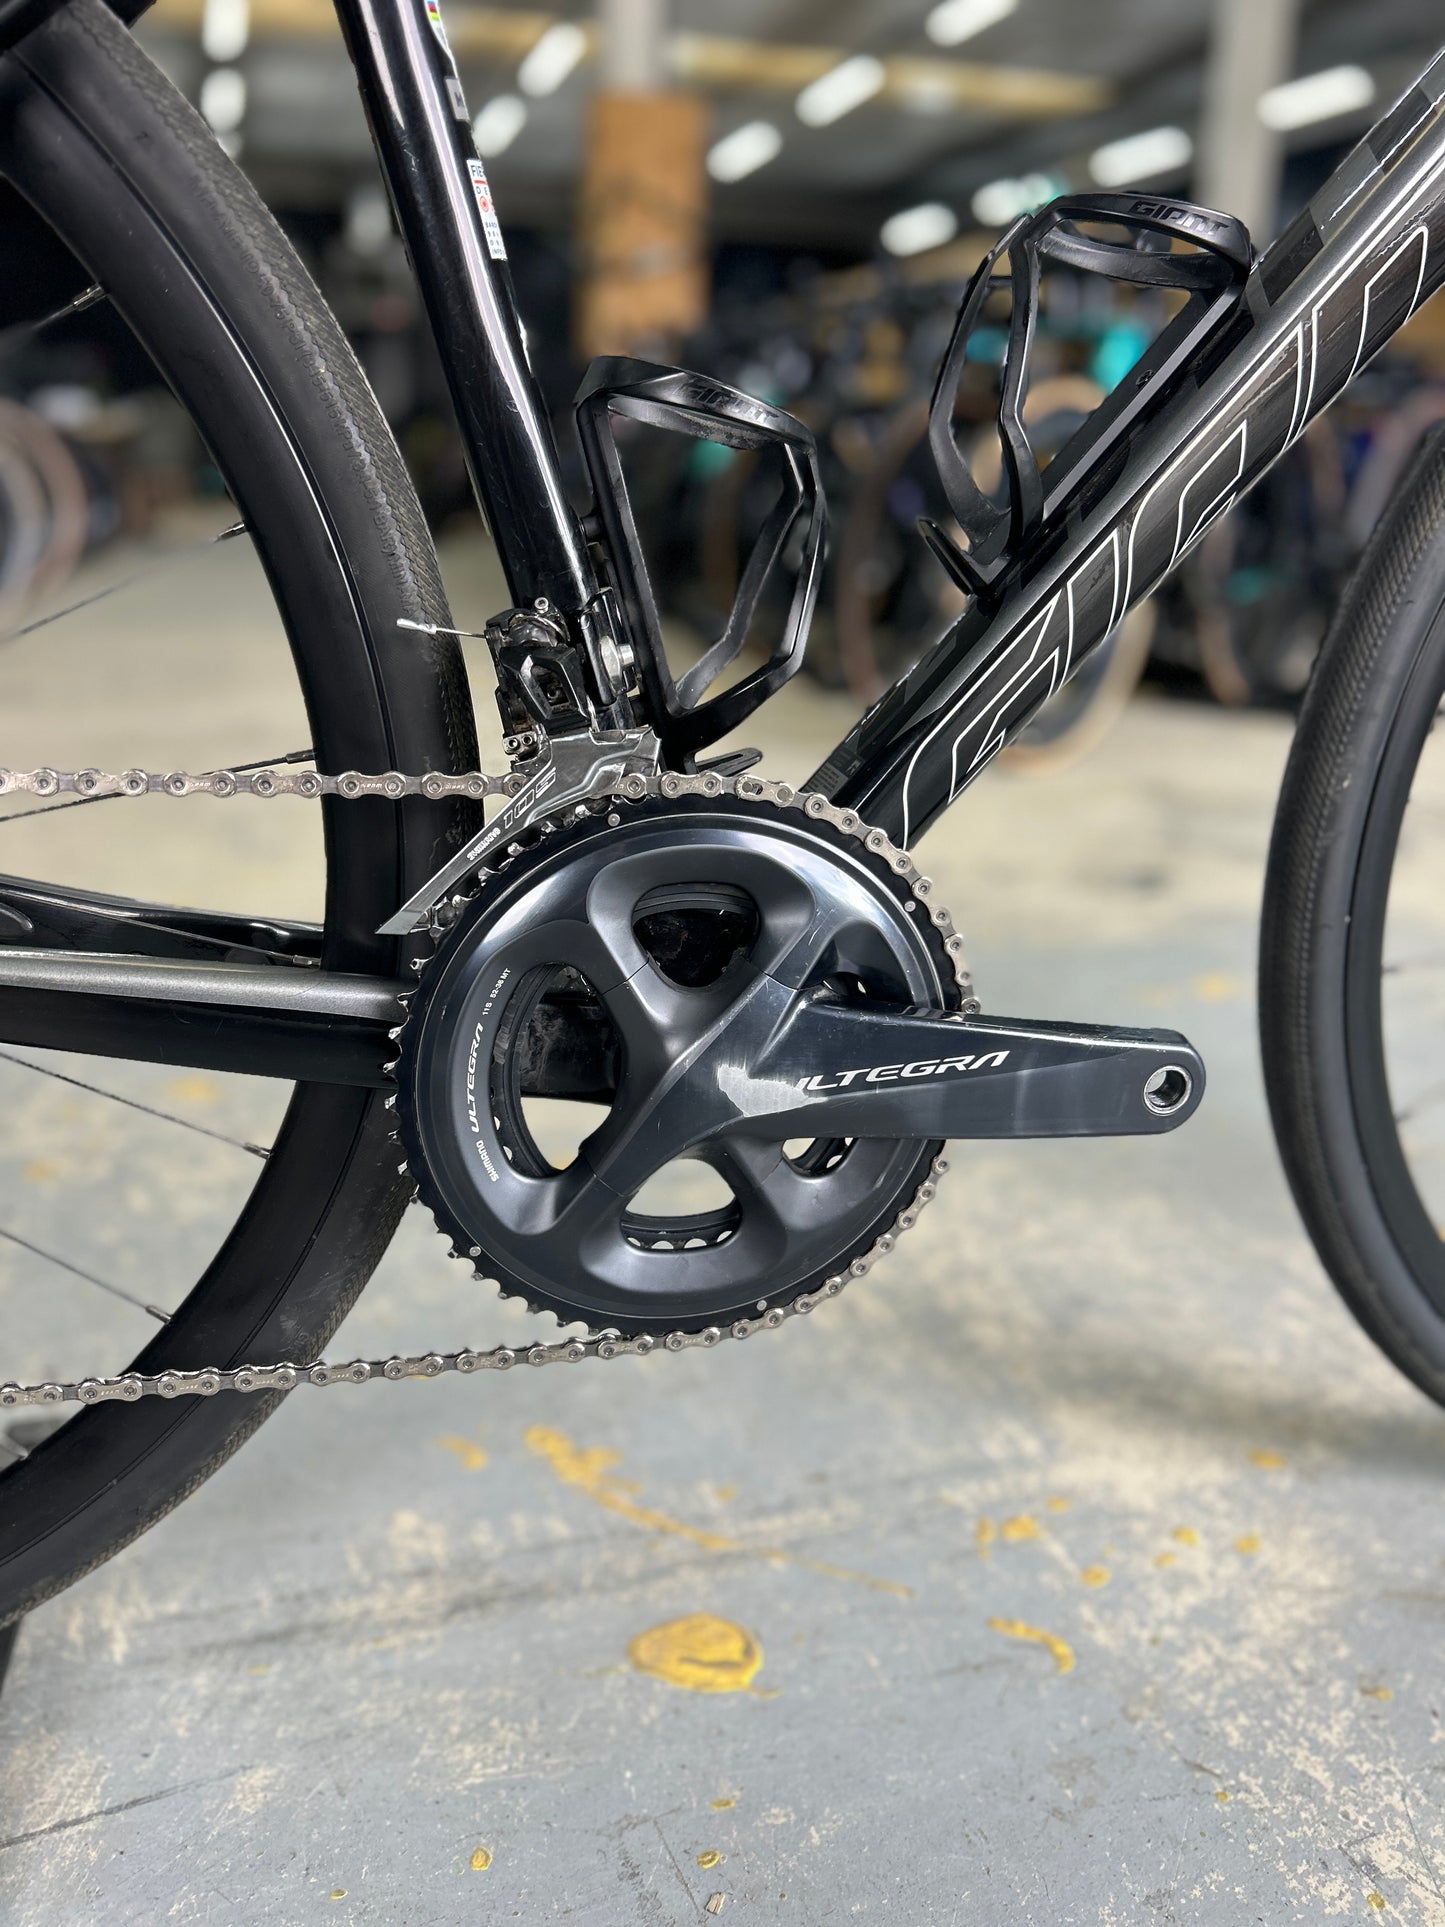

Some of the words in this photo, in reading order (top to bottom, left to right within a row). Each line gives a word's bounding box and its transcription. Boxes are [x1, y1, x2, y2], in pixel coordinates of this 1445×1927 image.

[1129, 200, 1230, 235] GIANT
[467, 827, 501, 860] SHIMANO
[504, 767, 556, 829] 105
[500, 967, 511, 979] MT
[466, 1022, 484, 1133] ULTEGRA
[476, 1140, 499, 1182] SHIMANO
